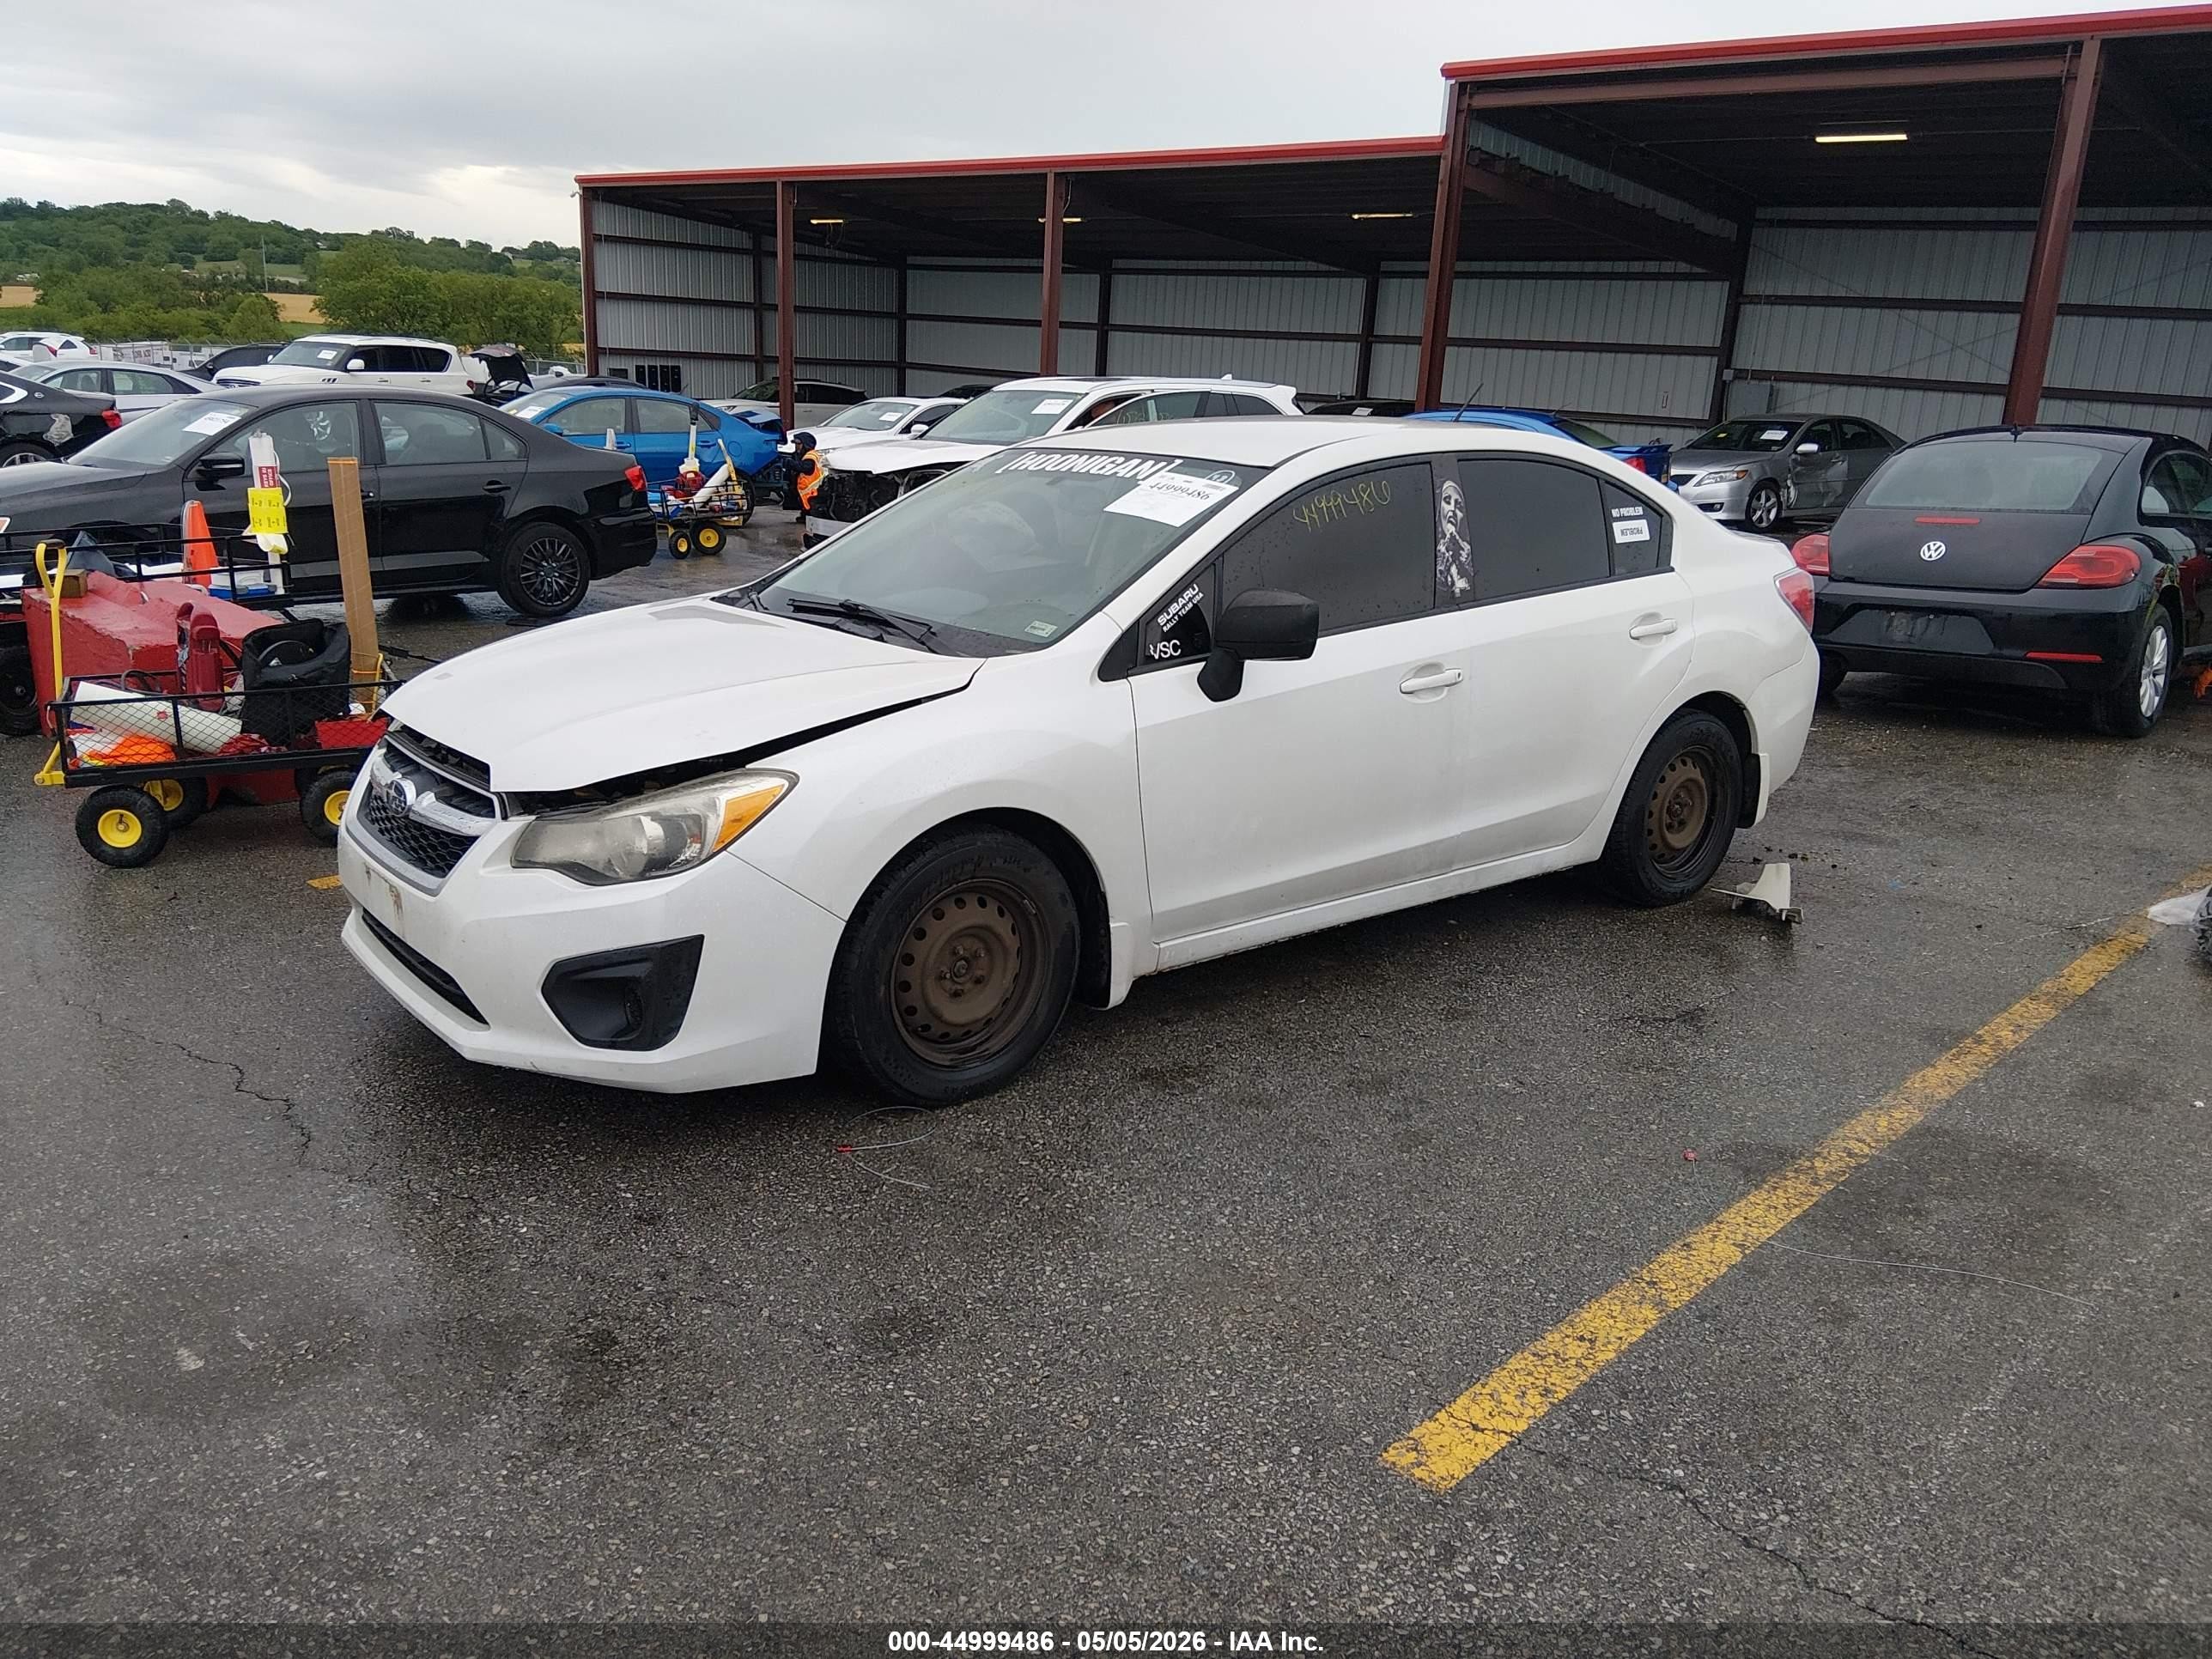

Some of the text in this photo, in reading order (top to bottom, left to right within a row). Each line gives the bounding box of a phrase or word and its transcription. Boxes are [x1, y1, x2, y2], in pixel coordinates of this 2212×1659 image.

[1157, 583, 1199, 626] SUBARU
[1162, 592, 1204, 633] RALLY TEAM USA
